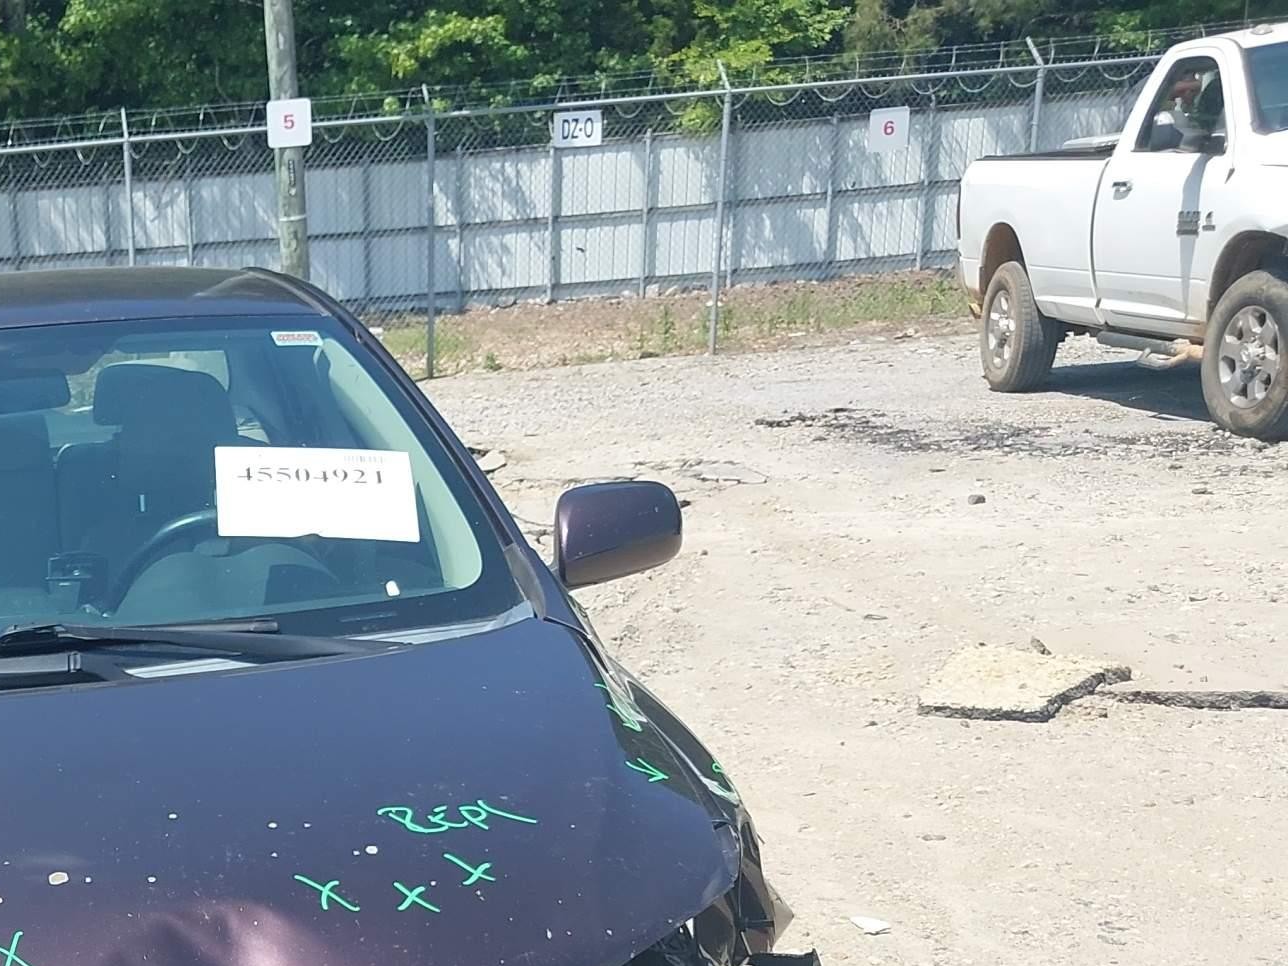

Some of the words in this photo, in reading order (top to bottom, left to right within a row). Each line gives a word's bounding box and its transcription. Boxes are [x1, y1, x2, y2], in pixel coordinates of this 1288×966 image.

[283, 113, 295, 130] 5
[884, 120, 895, 136] 6
[237, 466, 385, 485] 45504921
